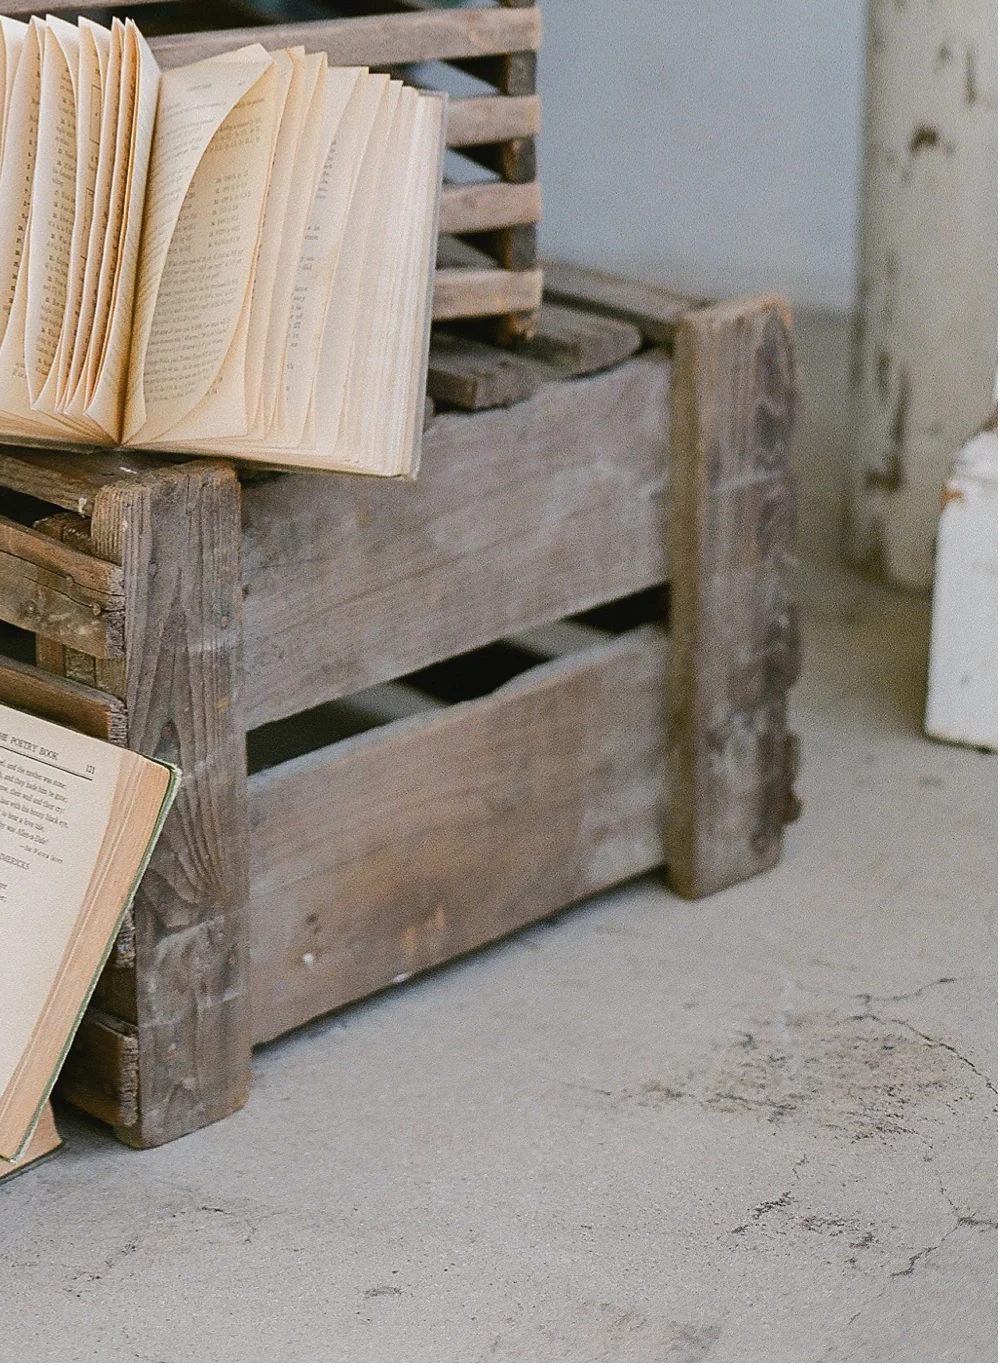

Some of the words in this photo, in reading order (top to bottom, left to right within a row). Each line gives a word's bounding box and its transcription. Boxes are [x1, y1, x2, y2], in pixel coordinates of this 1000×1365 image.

[10, 737, 38, 752] POETRY
[39, 747, 58, 760] BOOK
[86, 765, 95, 774] 121
